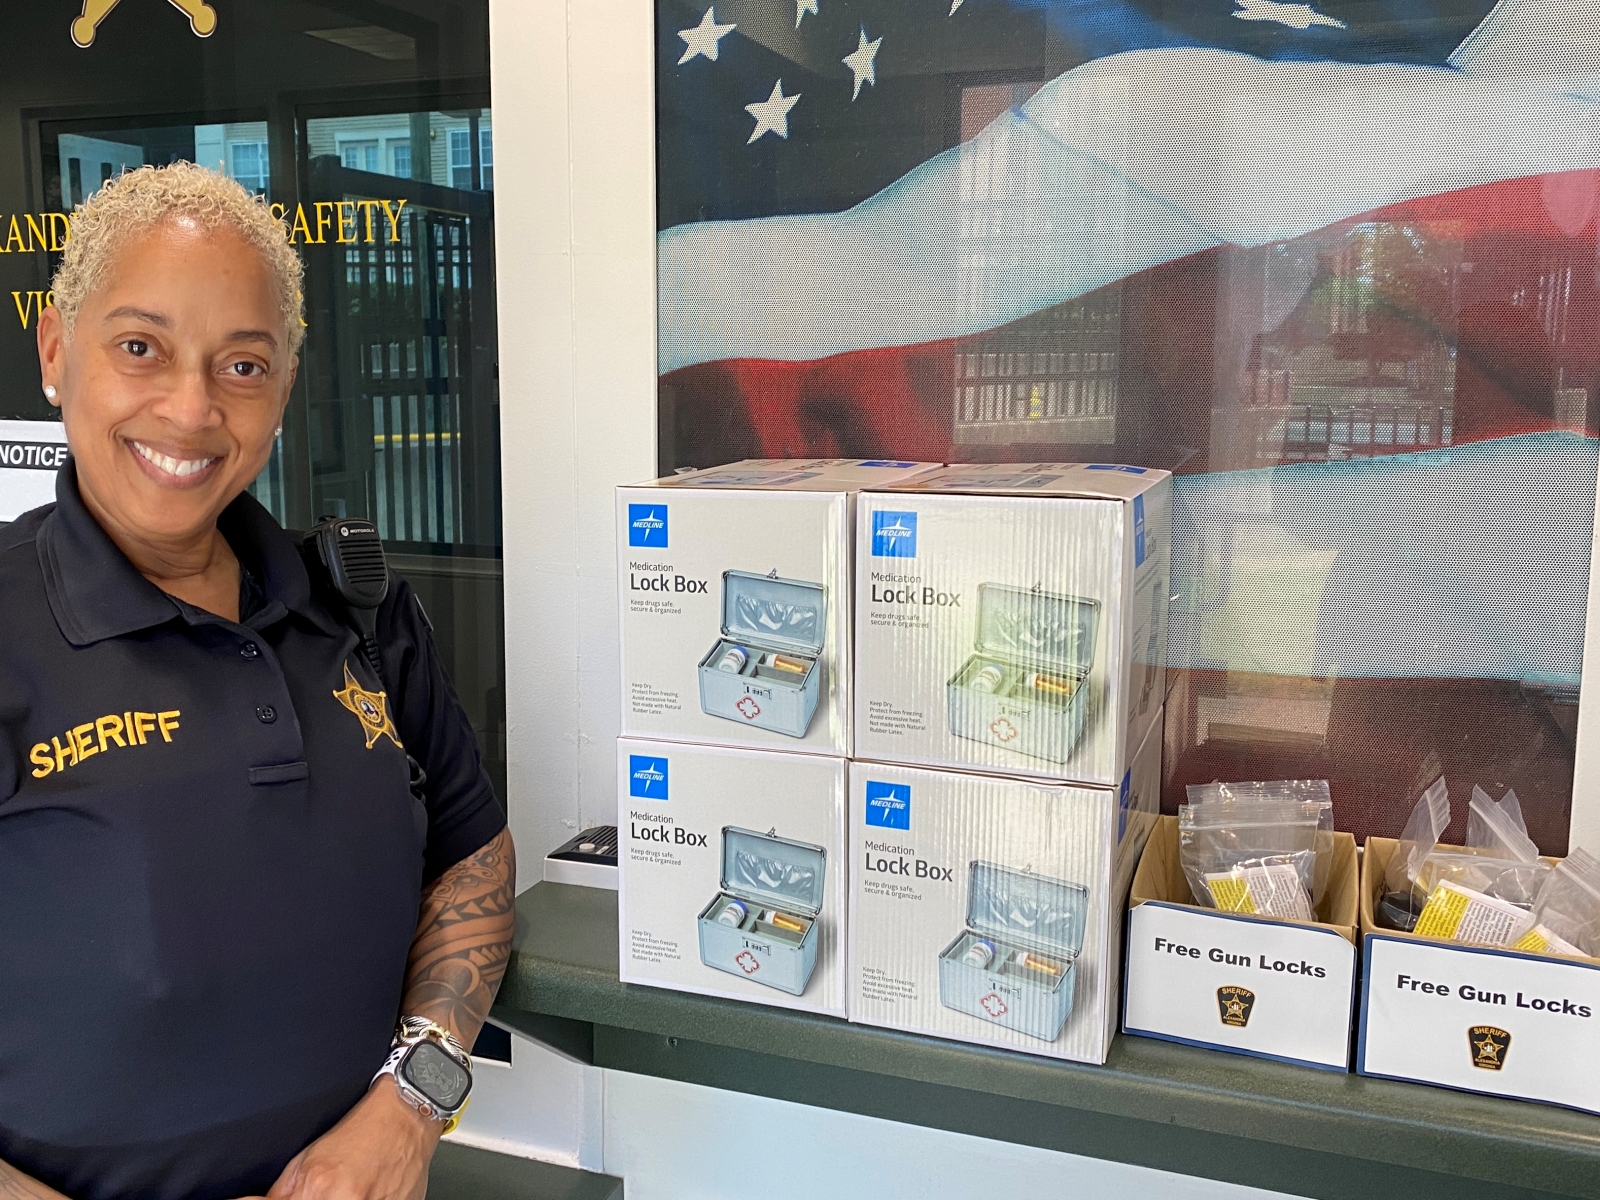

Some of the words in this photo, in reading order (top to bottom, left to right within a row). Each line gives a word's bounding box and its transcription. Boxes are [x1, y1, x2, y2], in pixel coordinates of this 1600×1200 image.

[268, 199, 407, 244] SAFETY
[0, 445, 68, 467] NOTICE
[632, 521, 664, 529] MEDLINE
[876, 530, 913, 538] MEDLINE
[629, 561, 674, 572] Medication
[630, 573, 670, 592] Lock
[674, 575, 708, 594] Box
[871, 572, 922, 583] Medication
[872, 584, 917, 604] Lock
[923, 587, 961, 607] Box
[630, 599, 644, 607] Keep
[645, 600, 660, 608] drugs
[654, 607, 682, 615] organized
[871, 612, 886, 620] Keep
[887, 613, 905, 621] drugs
[898, 621, 929, 629] organized
[29, 710, 181, 779] SHERIFF
[633, 772, 664, 781] MEDLINE
[870, 800, 906, 810] MEDLINE
[631, 811, 674, 824] Medication
[631, 822, 670, 843] Lock
[675, 827, 707, 848] Box
[631, 847, 644, 855] Keep
[645, 849, 661, 858] drugs
[662, 851, 675, 859] safe,
[865, 840, 915, 856] Medication
[655, 857, 682, 865] organized
[866, 852, 910, 876] Lock
[915, 859, 953, 882] Box
[864, 879, 880, 888] Keep
[881, 882, 899, 891] drugs
[900, 885, 915, 893] safe,
[864, 887, 885, 895] secure
[891, 891, 922, 901] organized
[1154, 937, 1201, 959] Free
[1208, 948, 1251, 967] Gun
[1259, 955, 1327, 978] Locks
[1221, 987, 1252, 998] SHERIFF
[1397, 974, 1450, 997] Free
[1458, 984, 1507, 1005] Gun
[1516, 992, 1592, 1018] Locks
[1473, 1027, 1508, 1038] SHERIFF
